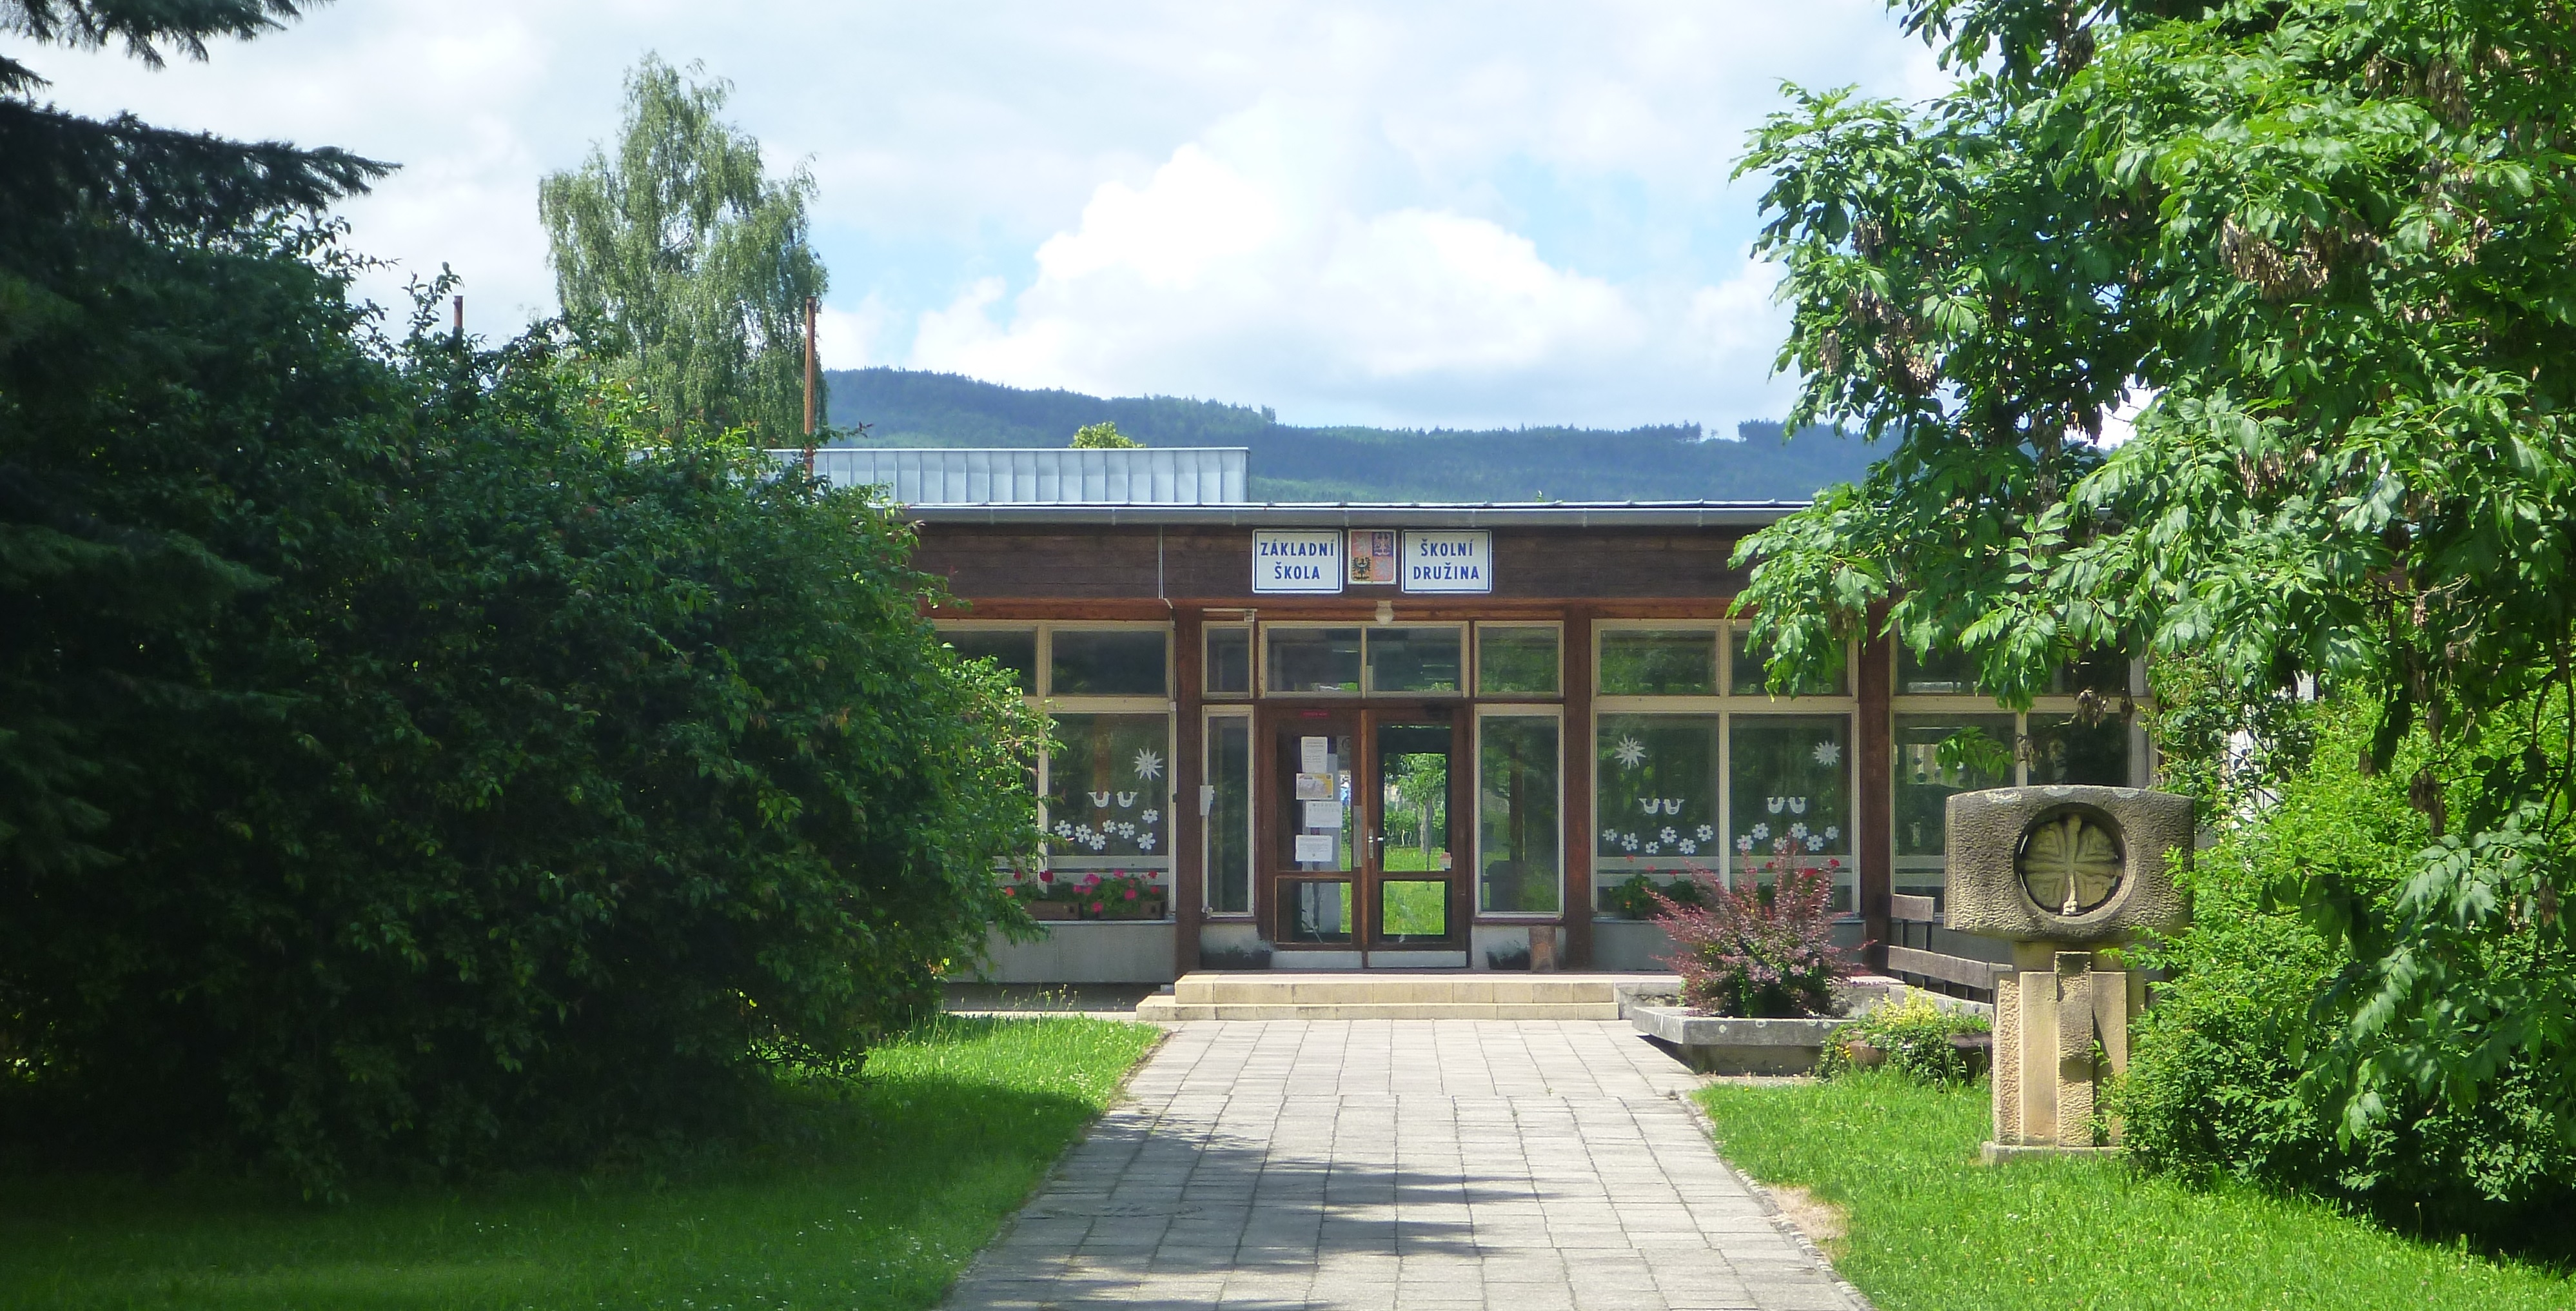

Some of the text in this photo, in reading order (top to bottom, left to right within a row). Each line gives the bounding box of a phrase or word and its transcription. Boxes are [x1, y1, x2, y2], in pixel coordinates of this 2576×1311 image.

[1261, 539, 1335, 556] ZÁKLADNÍ
[1421, 538, 1473, 557] ŠKOLNÍ
[1274, 562, 1320, 580] ŠKOLA
[1413, 562, 1479, 580] DRUŽINA
